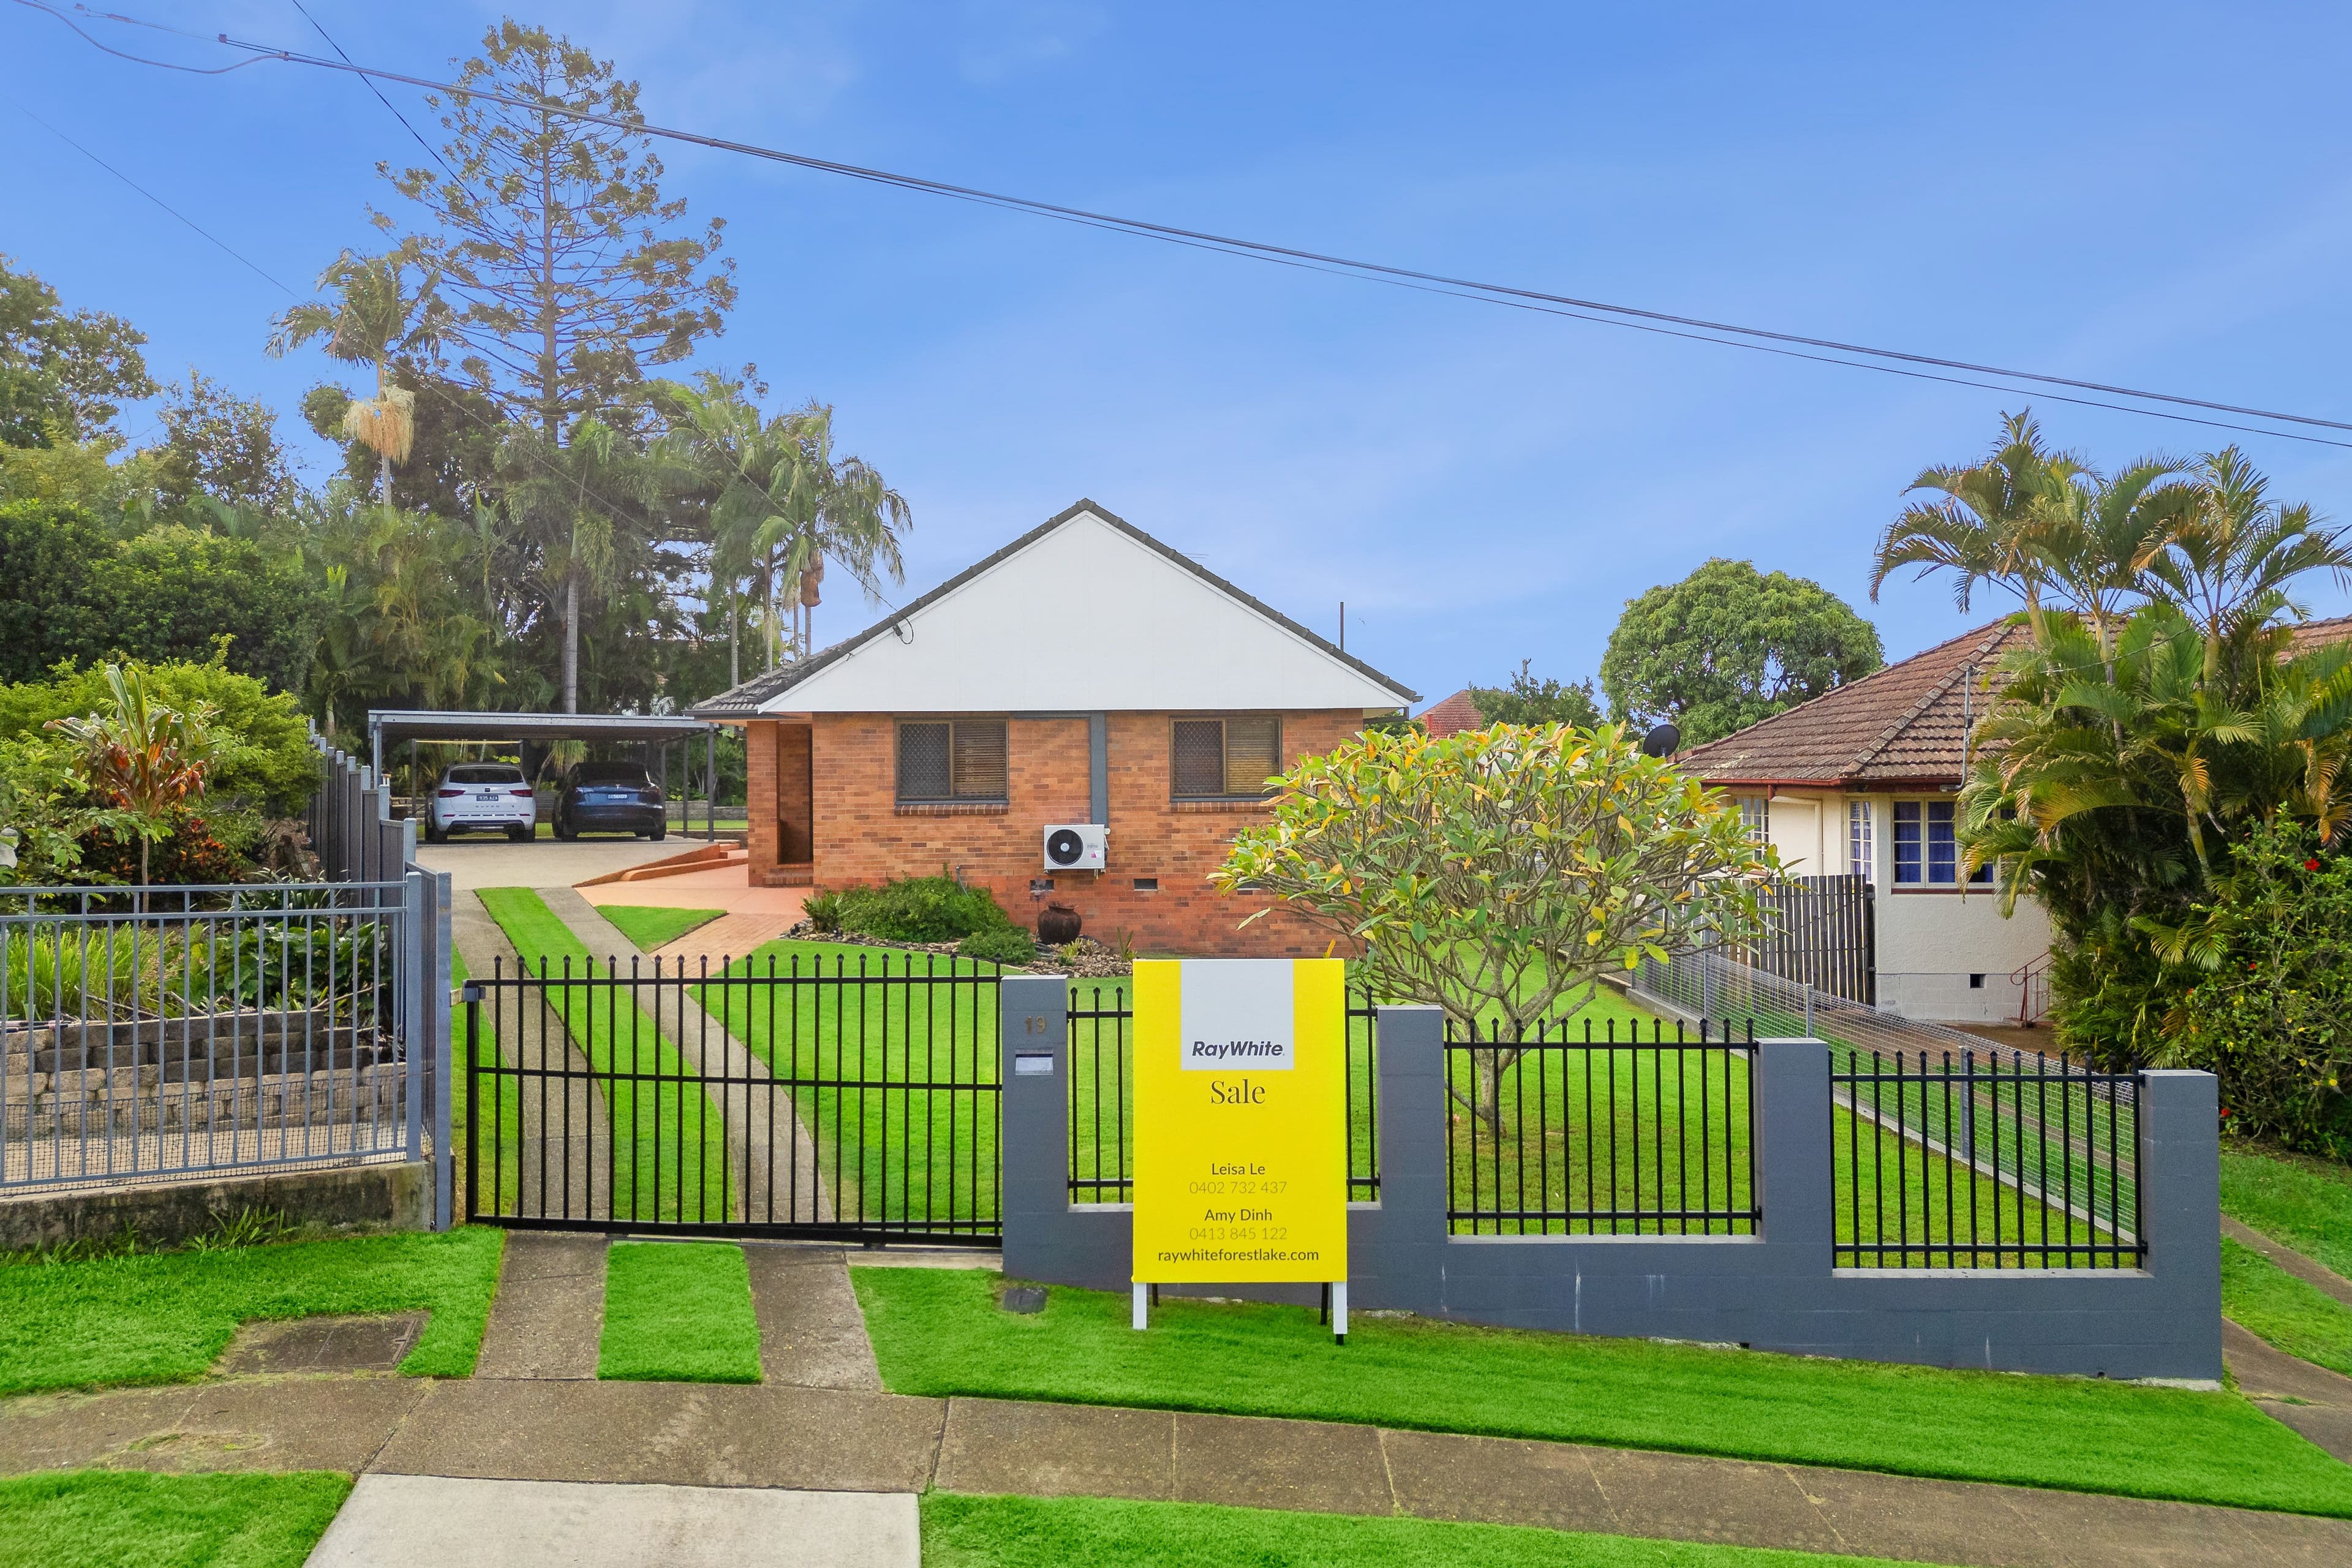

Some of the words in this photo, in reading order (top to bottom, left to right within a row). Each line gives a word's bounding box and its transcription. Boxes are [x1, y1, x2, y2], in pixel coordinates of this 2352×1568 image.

[1025, 1016, 1046, 1035] 19
[1210, 1079, 1266, 1104] Sale
[1212, 1163, 1245, 1175] Leisa
[1250, 1163, 1265, 1175] Le
[1189, 1181, 1225, 1194] 0402
[1229, 1181, 1256, 1194] 732
[1261, 1181, 1287, 1194] 437
[1204, 1208, 1236, 1224] Amy
[1240, 1208, 1272, 1221] Dinh
[1189, 1227, 1225, 1241] 0413
[1229, 1227, 1256, 1241] 845
[1261, 1227, 1287, 1241] 122
[1158, 1248, 1319, 1264] raywhiteforestlake.com
